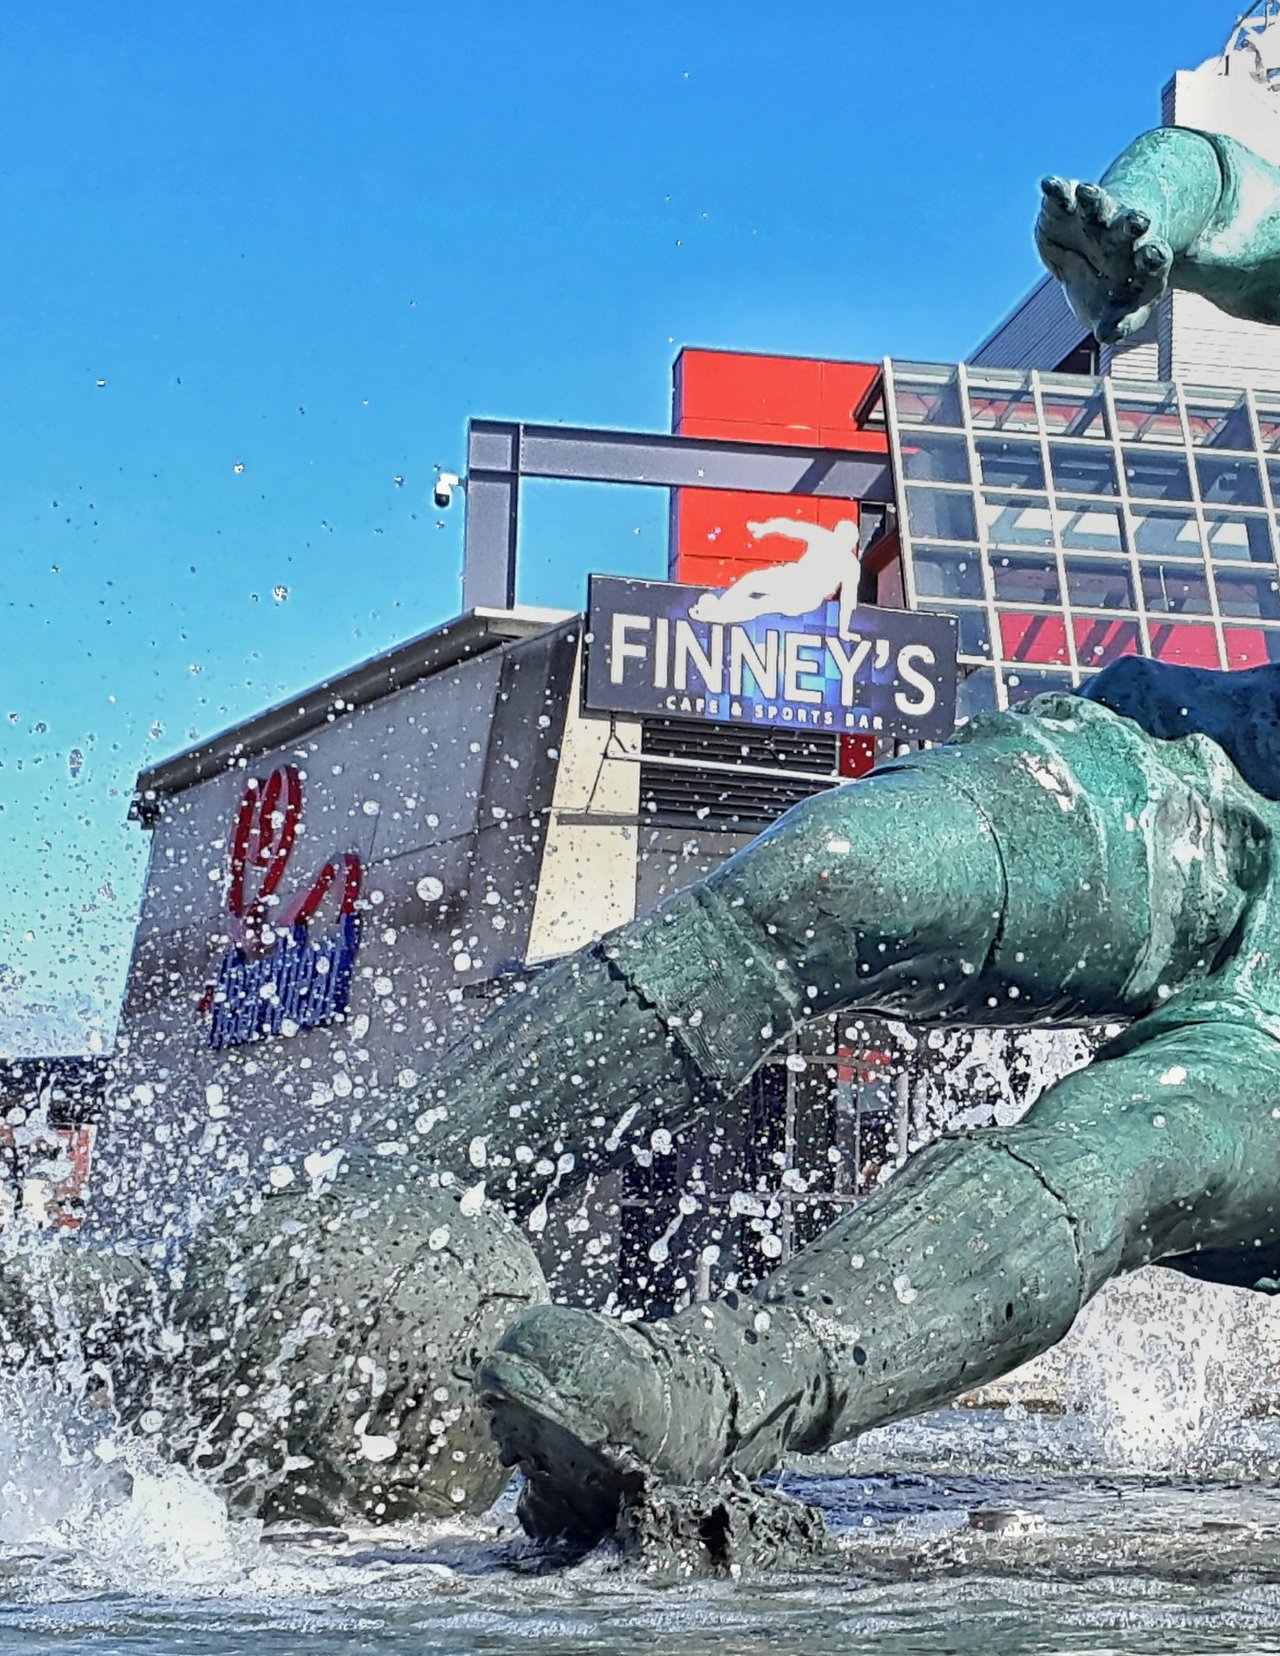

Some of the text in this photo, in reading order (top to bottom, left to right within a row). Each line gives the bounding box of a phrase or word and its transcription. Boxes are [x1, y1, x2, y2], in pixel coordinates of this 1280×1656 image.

[611, 613, 936, 715] FINNEY'S
[666, 696, 883, 730] CAFE & SPORTS BAR
